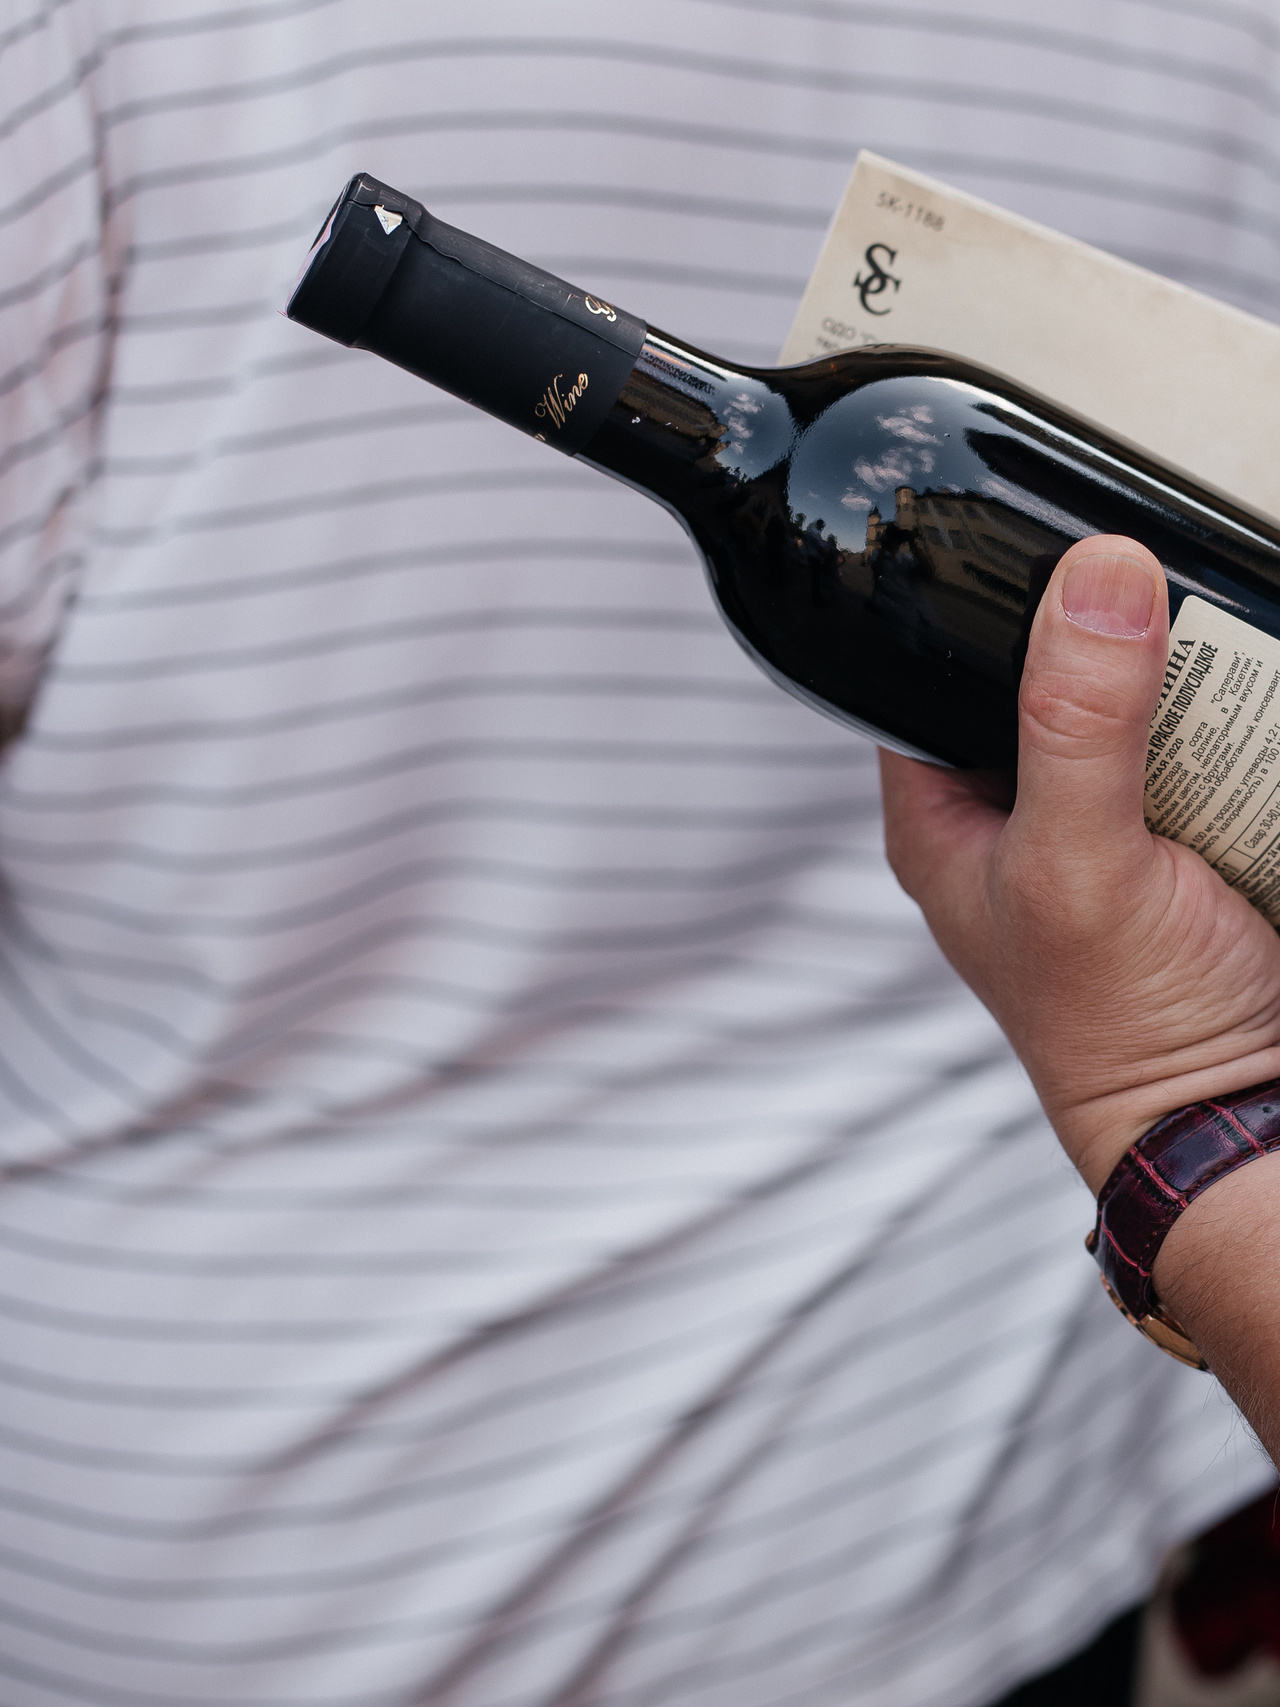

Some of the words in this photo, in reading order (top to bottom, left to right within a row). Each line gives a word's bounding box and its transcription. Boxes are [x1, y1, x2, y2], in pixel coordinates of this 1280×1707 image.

[535, 373, 588, 429] Wine
[1147, 706, 1183, 751] КРАСНОЕ
[1170, 640, 1218, 713] ПОЛУСЛАДКОЕ
[1150, 760, 1183, 800] винограда
[1188, 720, 1208, 747] сорта
[1210, 650, 1245, 704] "Саперави",
[1152, 767, 1190, 811] Алазанской
[1191, 724, 1220, 761] Долине,
[1220, 706, 1229, 714] в
[1228, 655, 1253, 696] Кахетии.
[1177, 770, 1203, 800] цветом,
[1199, 703, 1242, 769] неповторимым
[1239, 668, 1259, 702] вкусом
[1255, 659, 1263, 667] и
[1142, 758, 1169, 796] РОЖАЯ
[1164, 736, 1184, 760] 2020
[1178, 785, 1217, 831] виноградный
[1212, 721, 1258, 787] обработанный,
[1192, 830, 1207, 844] 100
[1212, 785, 1243, 822] продукта:
[1240, 745, 1269, 787] углеводы
[1263, 727, 1278, 745] 4,2
[1201, 740, 1234, 784] фруктами.
[1215, 774, 1264, 835] (калорийность)
[1260, 766, 1268, 774] в
[1264, 746, 1280, 765] 100
[1243, 827, 1268, 850] Сахар
[1259, 808, 1280, 831] 30-80
[1267, 848, 1278, 858] 24
